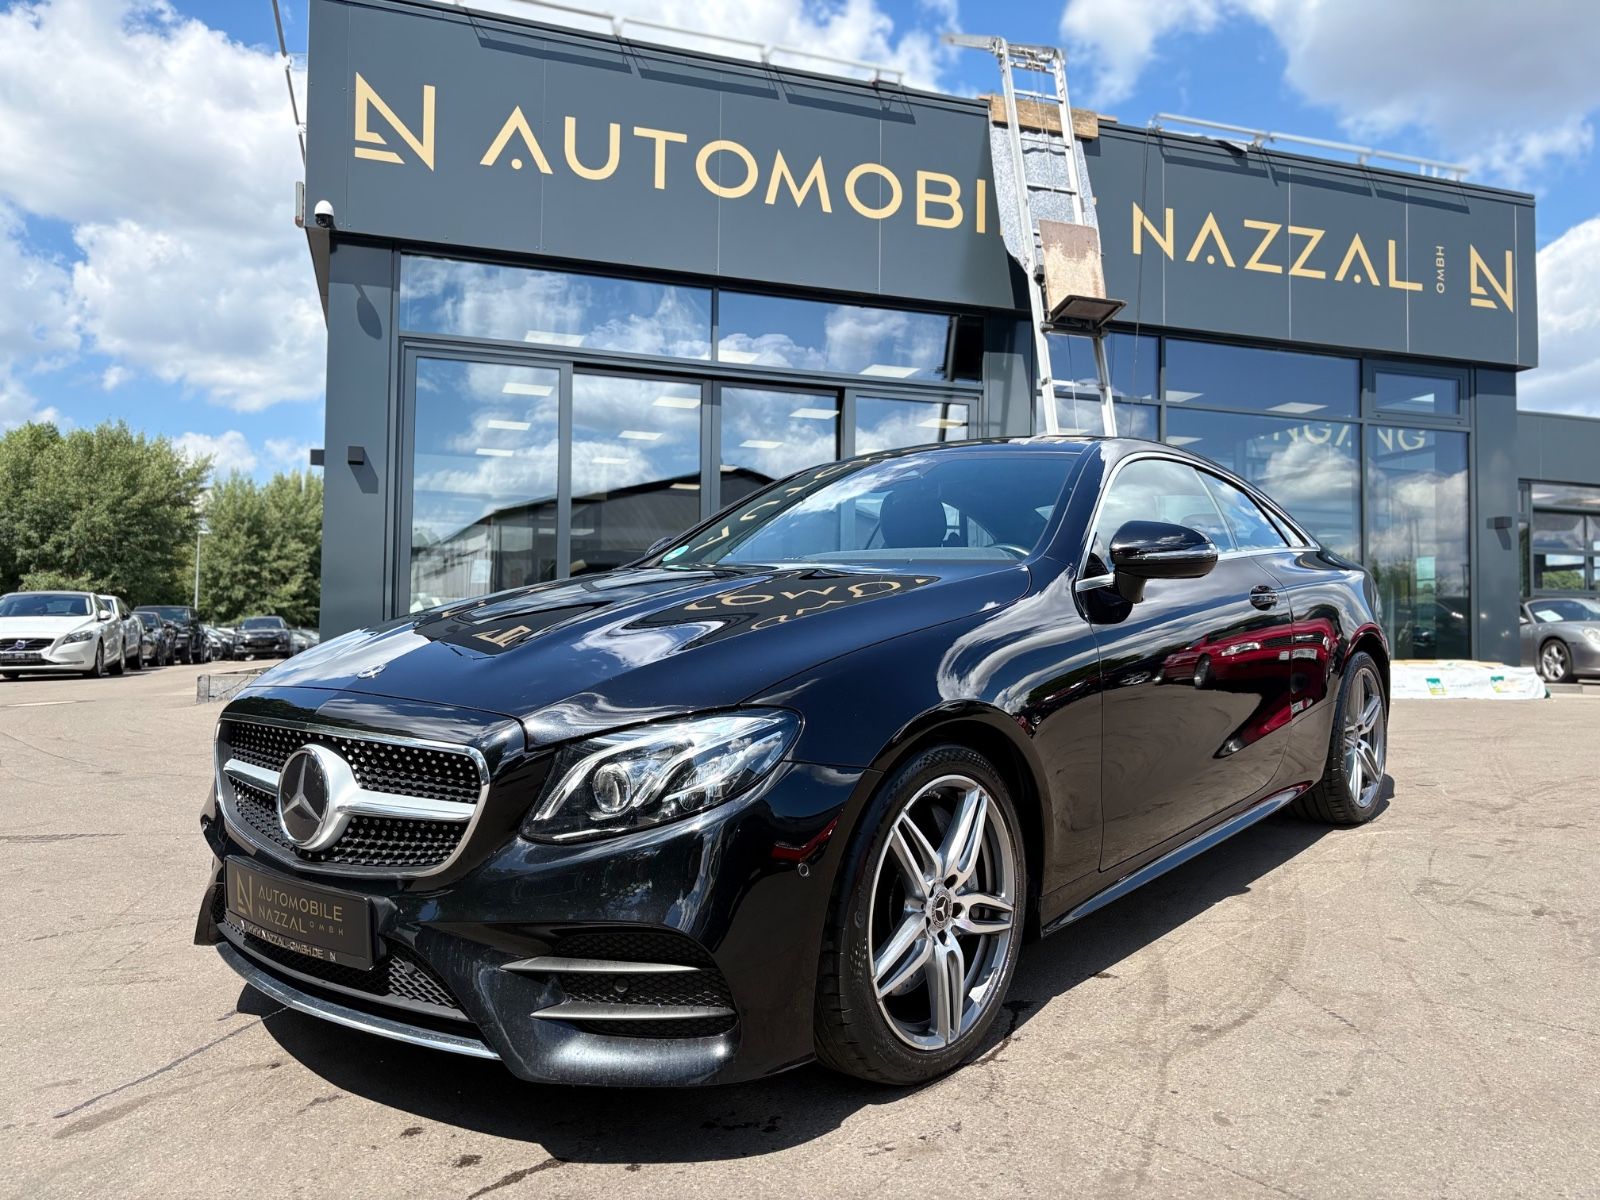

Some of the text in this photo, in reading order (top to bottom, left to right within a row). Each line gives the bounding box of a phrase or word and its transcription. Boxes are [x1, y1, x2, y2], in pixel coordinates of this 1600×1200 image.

[479, 105, 1097, 236] AUTOMOBI
[1132, 202, 1424, 292] NAZZAL
[258, 885, 343, 922] AUTOMOBILE
[258, 905, 308, 934] NAZZAL
